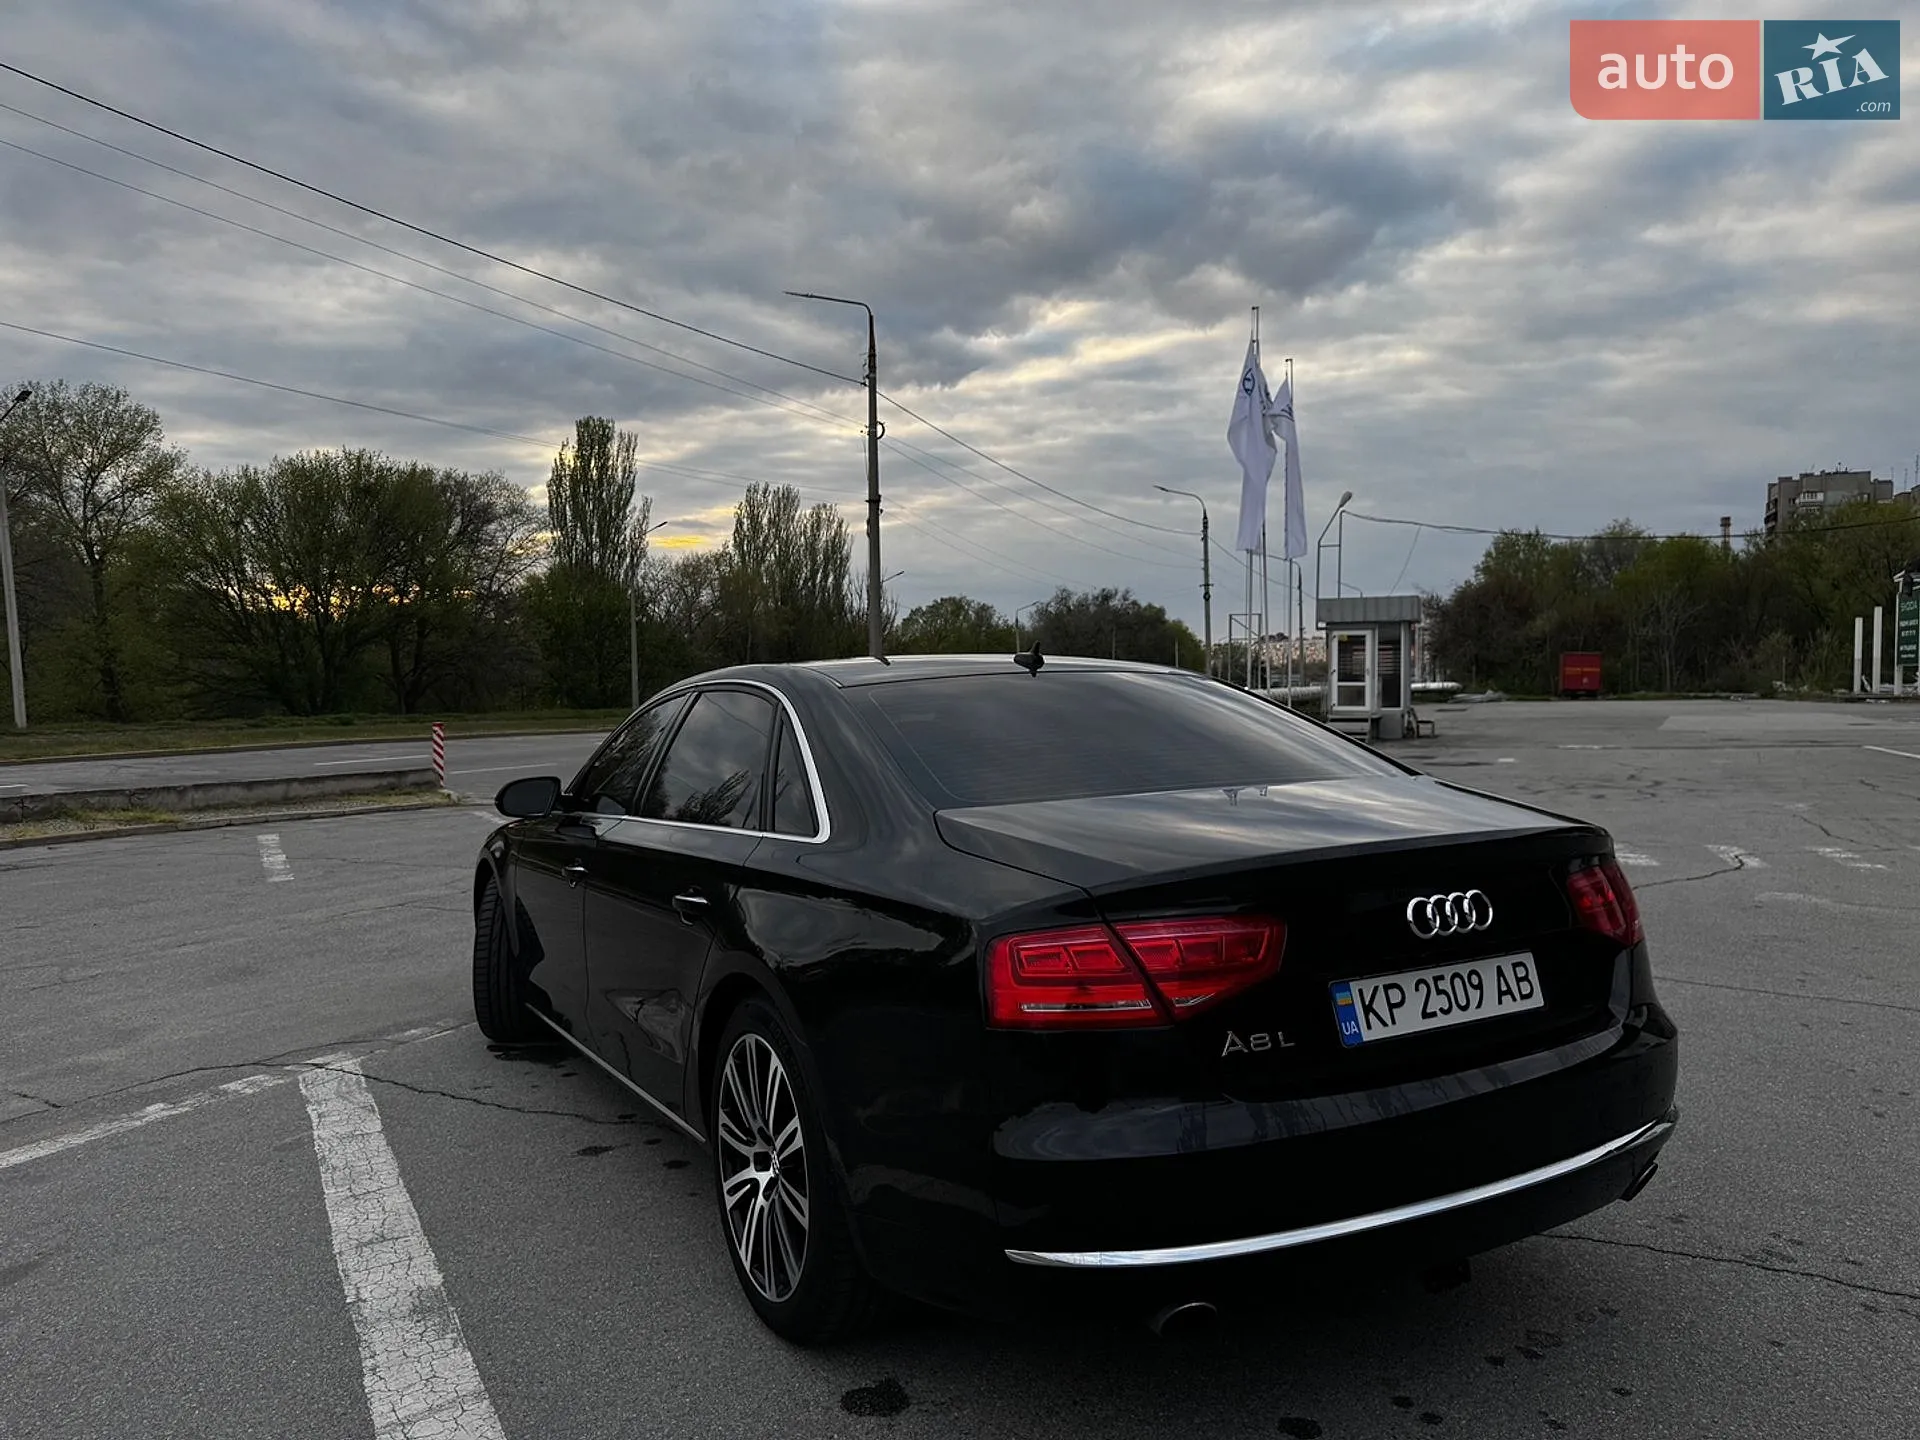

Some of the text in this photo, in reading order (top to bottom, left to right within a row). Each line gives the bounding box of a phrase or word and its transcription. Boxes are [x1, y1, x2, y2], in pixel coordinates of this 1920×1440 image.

[1358, 960, 1535, 1031] KP 2509 AB
[1342, 1020, 1359, 1036] UA
